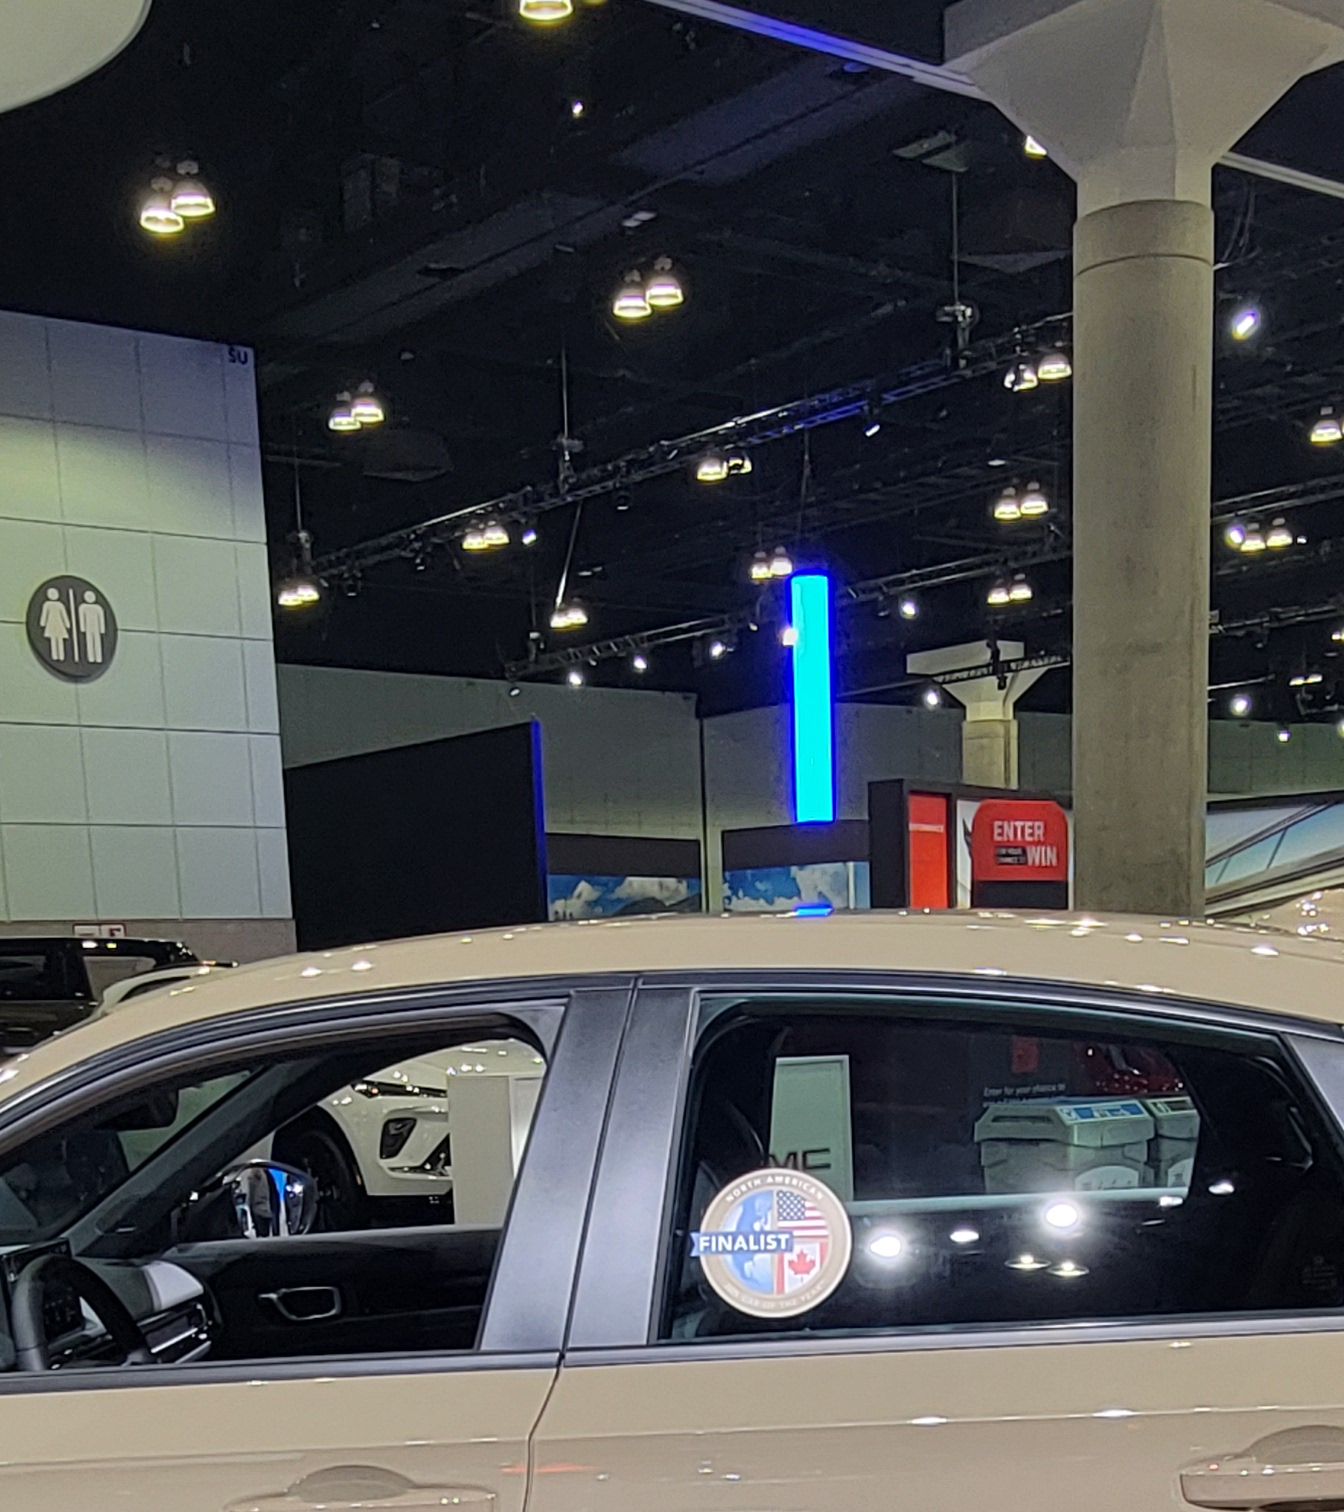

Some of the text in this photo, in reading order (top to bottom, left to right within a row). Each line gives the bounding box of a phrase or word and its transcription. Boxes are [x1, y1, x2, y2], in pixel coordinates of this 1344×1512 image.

[228, 346, 248, 365] SU
[993, 820, 1045, 841] ENTER
[1026, 845, 1057, 866] WIN
[725, 1175, 824, 1202] NORTH AMERICAN
[699, 1233, 790, 1252] FINALIST
